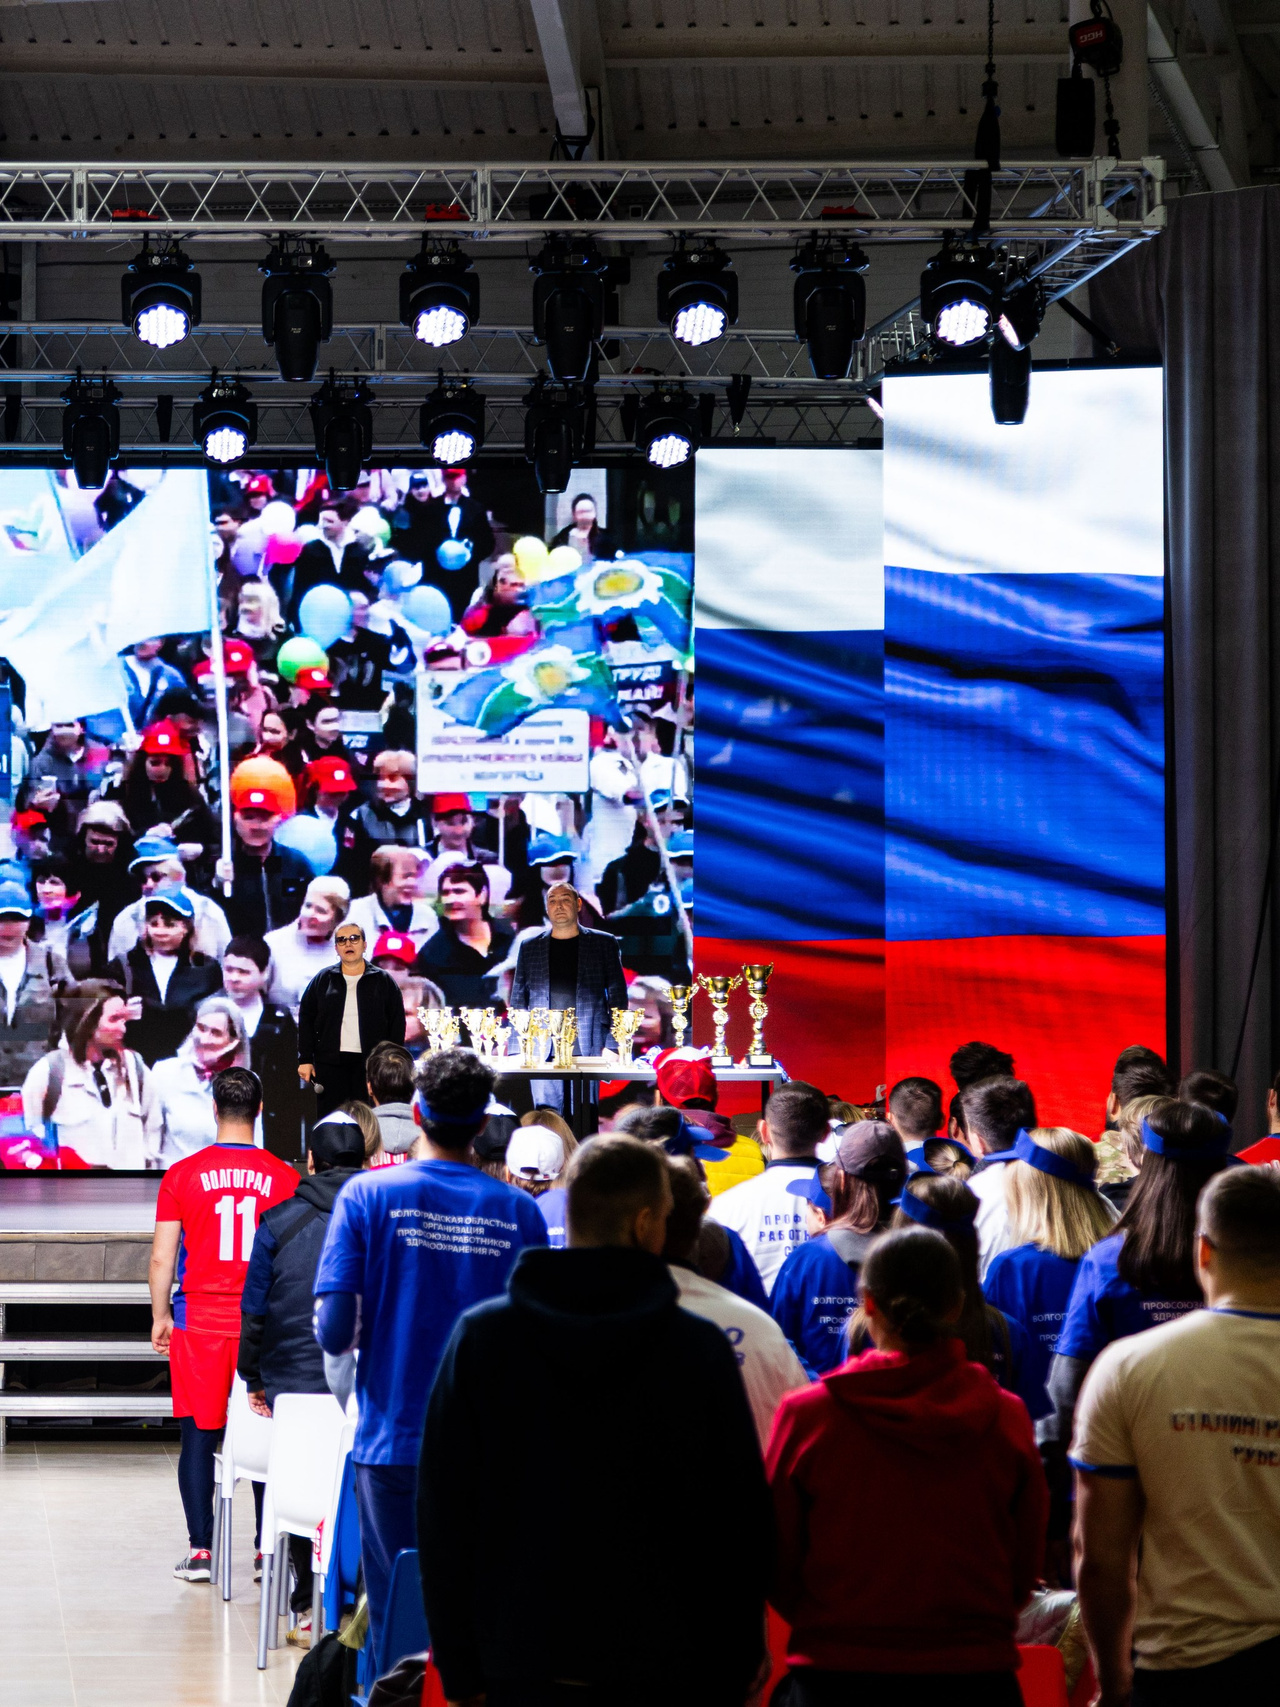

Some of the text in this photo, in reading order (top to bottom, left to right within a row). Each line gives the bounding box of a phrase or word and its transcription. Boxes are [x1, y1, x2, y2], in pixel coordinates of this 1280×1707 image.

[200, 1168, 273, 1198] ВОЛГОГРАД
[214, 1195, 257, 1262] 11
[389, 1209, 518, 1231] ВОЛГОГРАДСКАЯ ОБЛАСТНАЯ
[423, 1221, 485, 1235] ОРГАНИЗАЦИЯ
[397, 1228, 511, 1249] ПРОФСОЮЗА РАБОТНИКОВ
[488, 1248, 501, 1257] РФ
